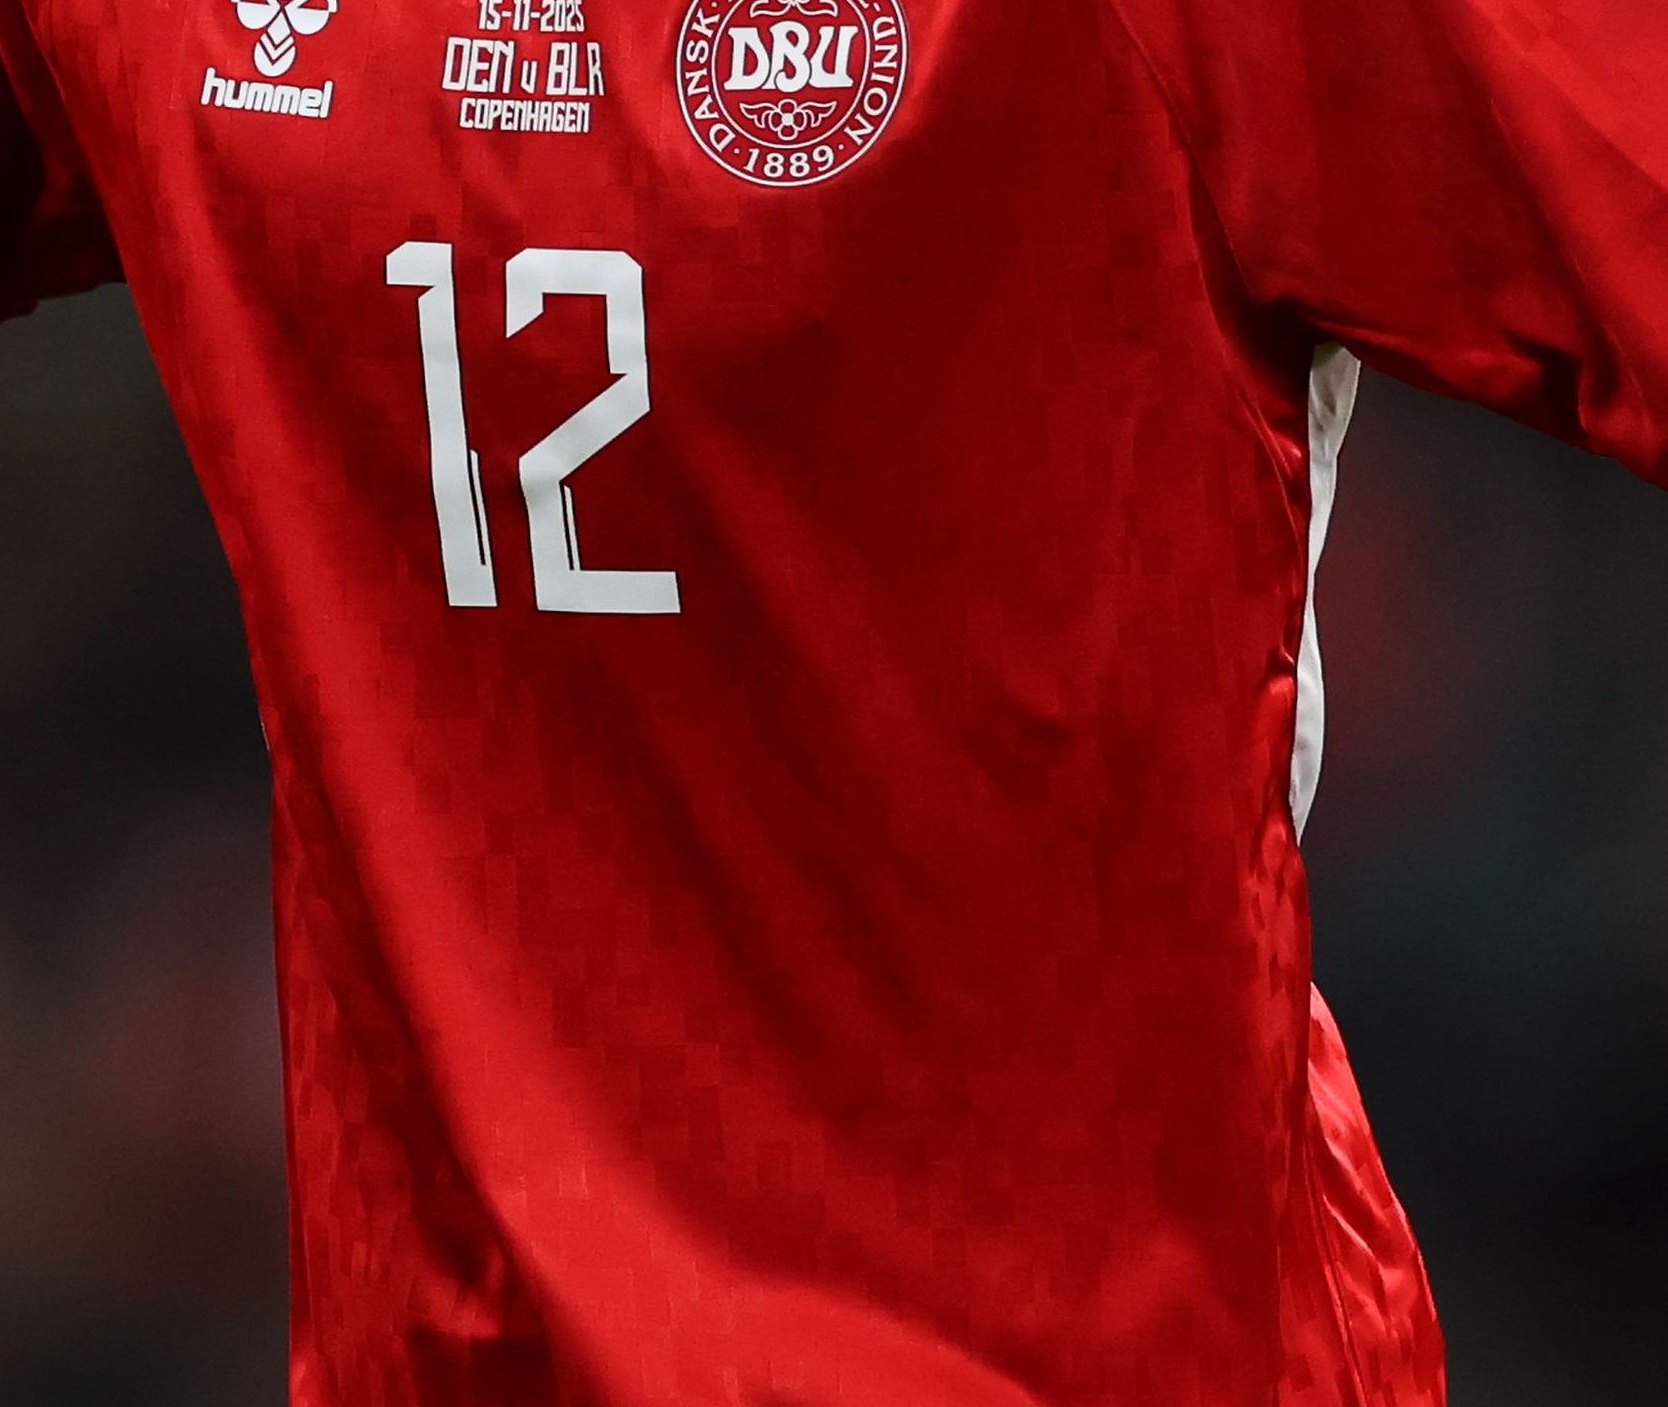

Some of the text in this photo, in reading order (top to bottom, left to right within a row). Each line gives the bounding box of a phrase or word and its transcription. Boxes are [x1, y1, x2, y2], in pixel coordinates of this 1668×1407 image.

[441, 36, 515, 94] DEN
[545, 41, 605, 96] BLR
[685, 8, 737, 152] DANSK
[723, 20, 859, 93] DBU
[200, 66, 333, 119] hummel
[459, 97, 590, 133] COPENHAGEN
[743, 145, 836, 178] 1889
[386, 240, 681, 614] 12
